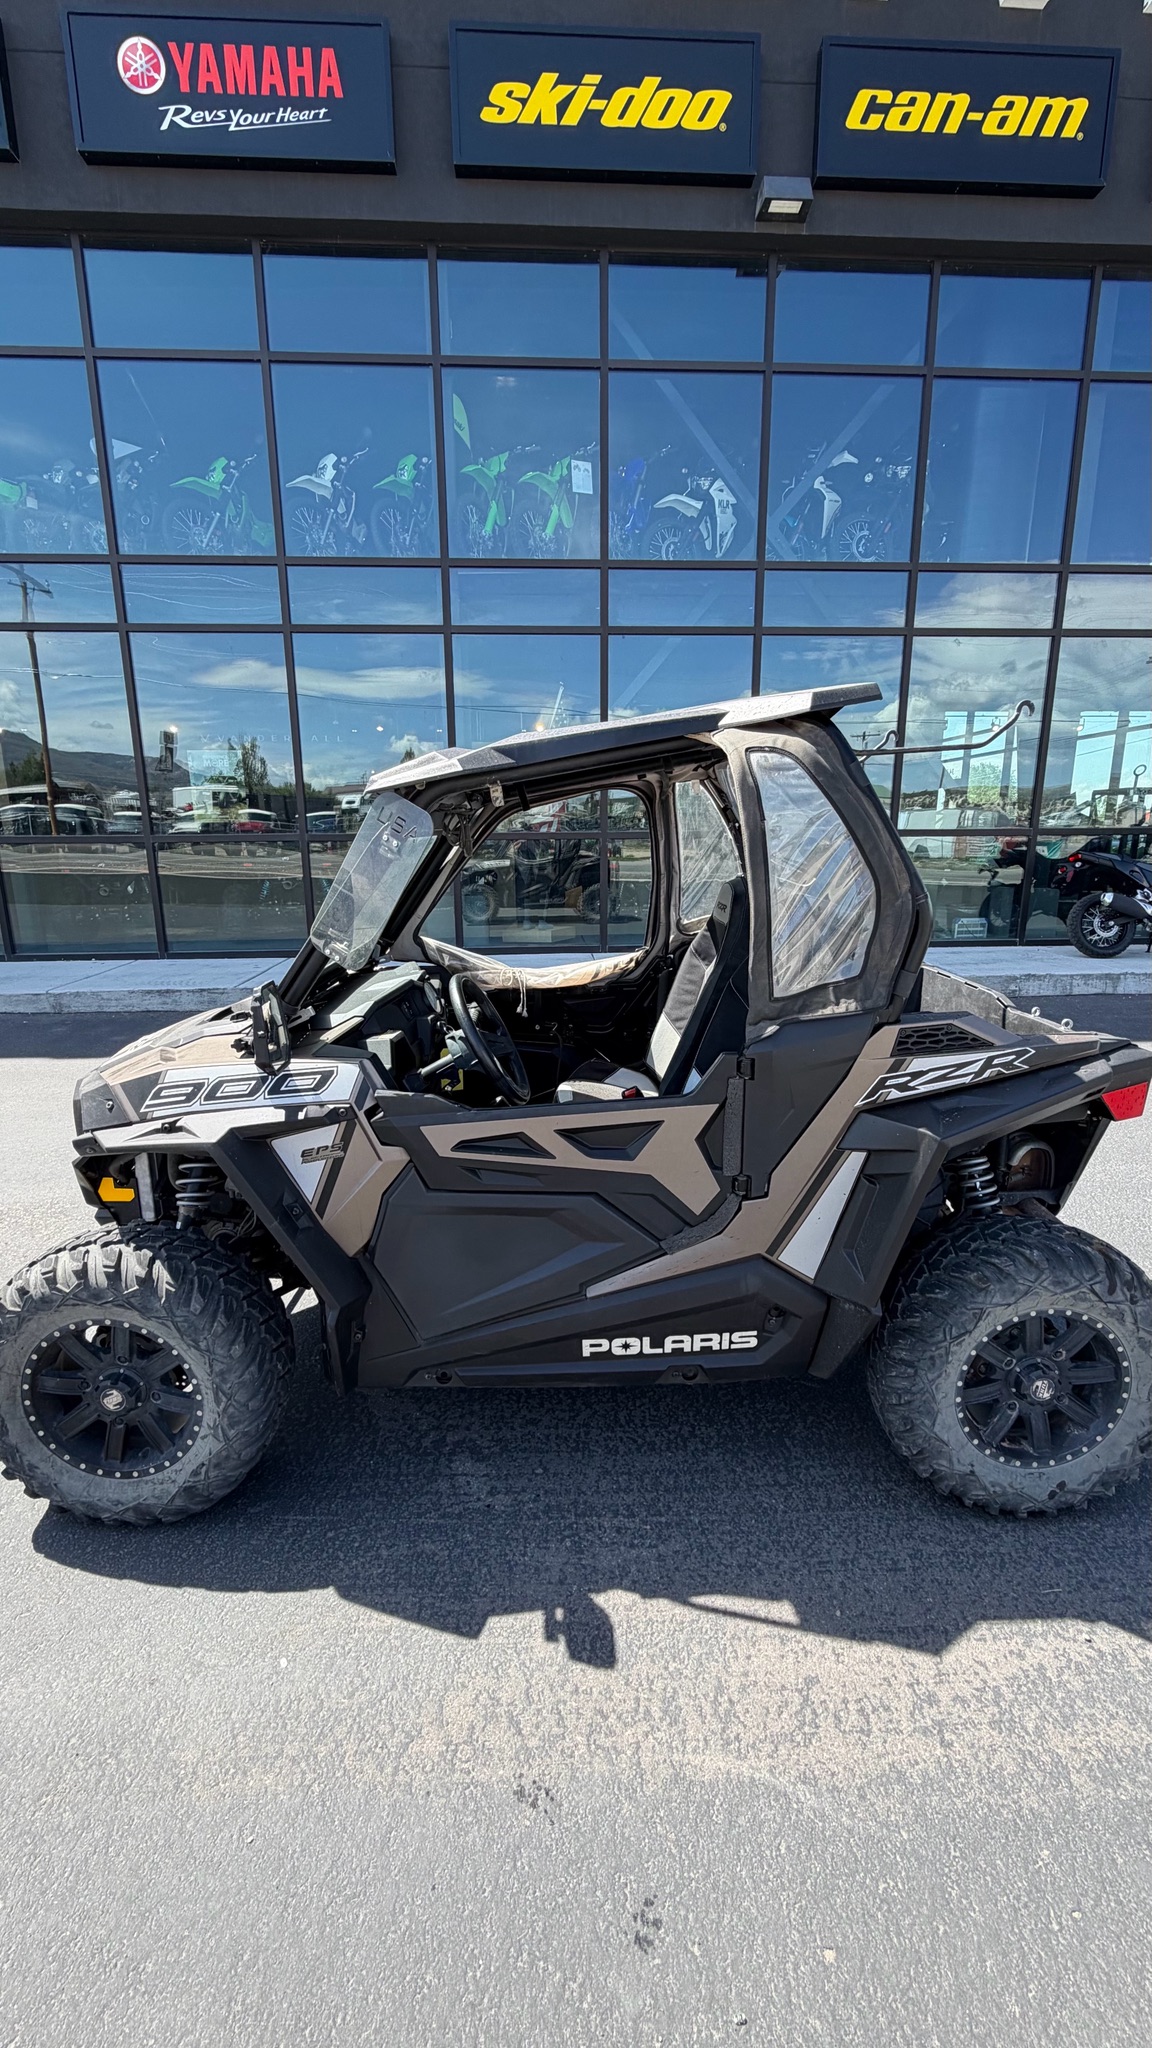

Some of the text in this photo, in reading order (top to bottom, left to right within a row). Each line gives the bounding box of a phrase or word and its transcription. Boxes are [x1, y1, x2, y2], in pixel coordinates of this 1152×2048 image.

[167, 41, 344, 99] YAMAHA
[158, 104, 329, 131] Revs Your Heart
[479, 71, 733, 131] ski-doo
[845, 88, 1090, 139] can-am
[376, 806, 418, 844] USA
[140, 1065, 339, 1113] 900
[854, 1047, 1036, 1107] RZR
[301, 1142, 344, 1158] EPS
[581, 1330, 758, 1357] POLARIS
